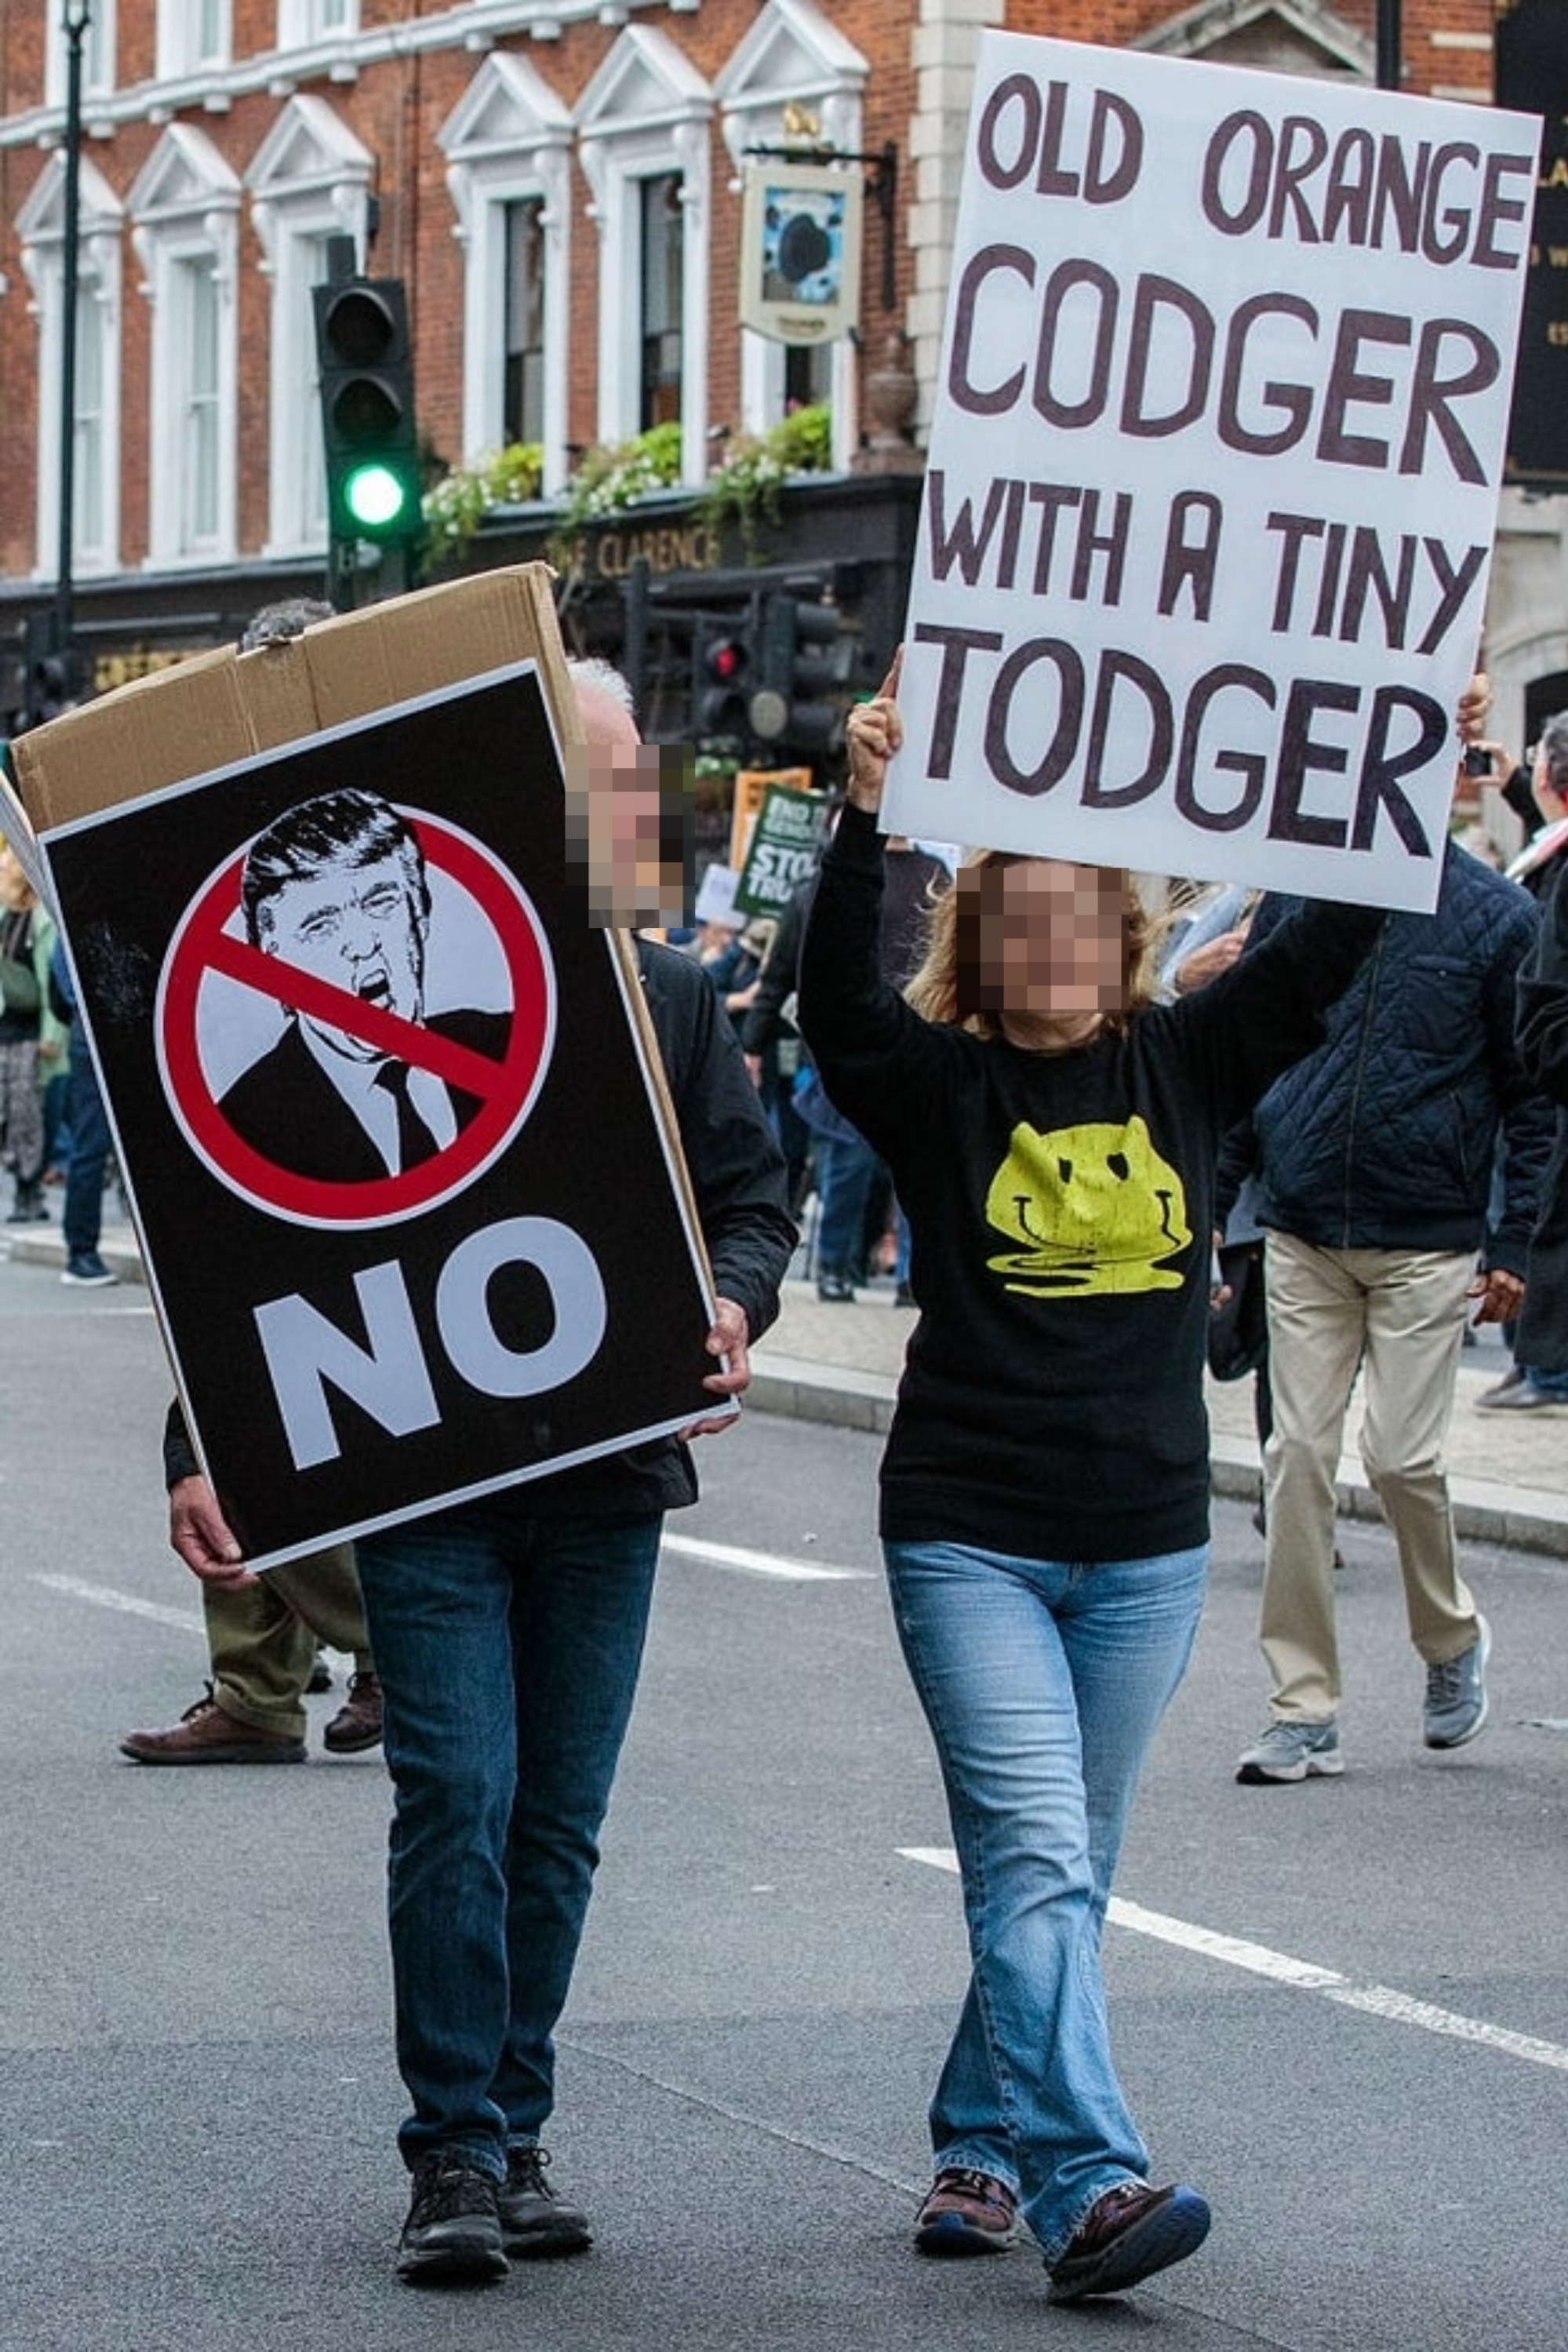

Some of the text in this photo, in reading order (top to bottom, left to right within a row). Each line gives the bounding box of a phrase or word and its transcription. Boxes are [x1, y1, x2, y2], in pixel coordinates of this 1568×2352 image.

[978, 74, 1533, 270] OLD ORANGE
[948, 243, 1501, 487] CODGER
[929, 470, 1488, 656] WITH A TINY
[914, 622, 1449, 859] TODGER
[748, 872, 794, 903] TRU
[751, 843, 820, 884] STO
[253, 1215, 607, 1470] NO
